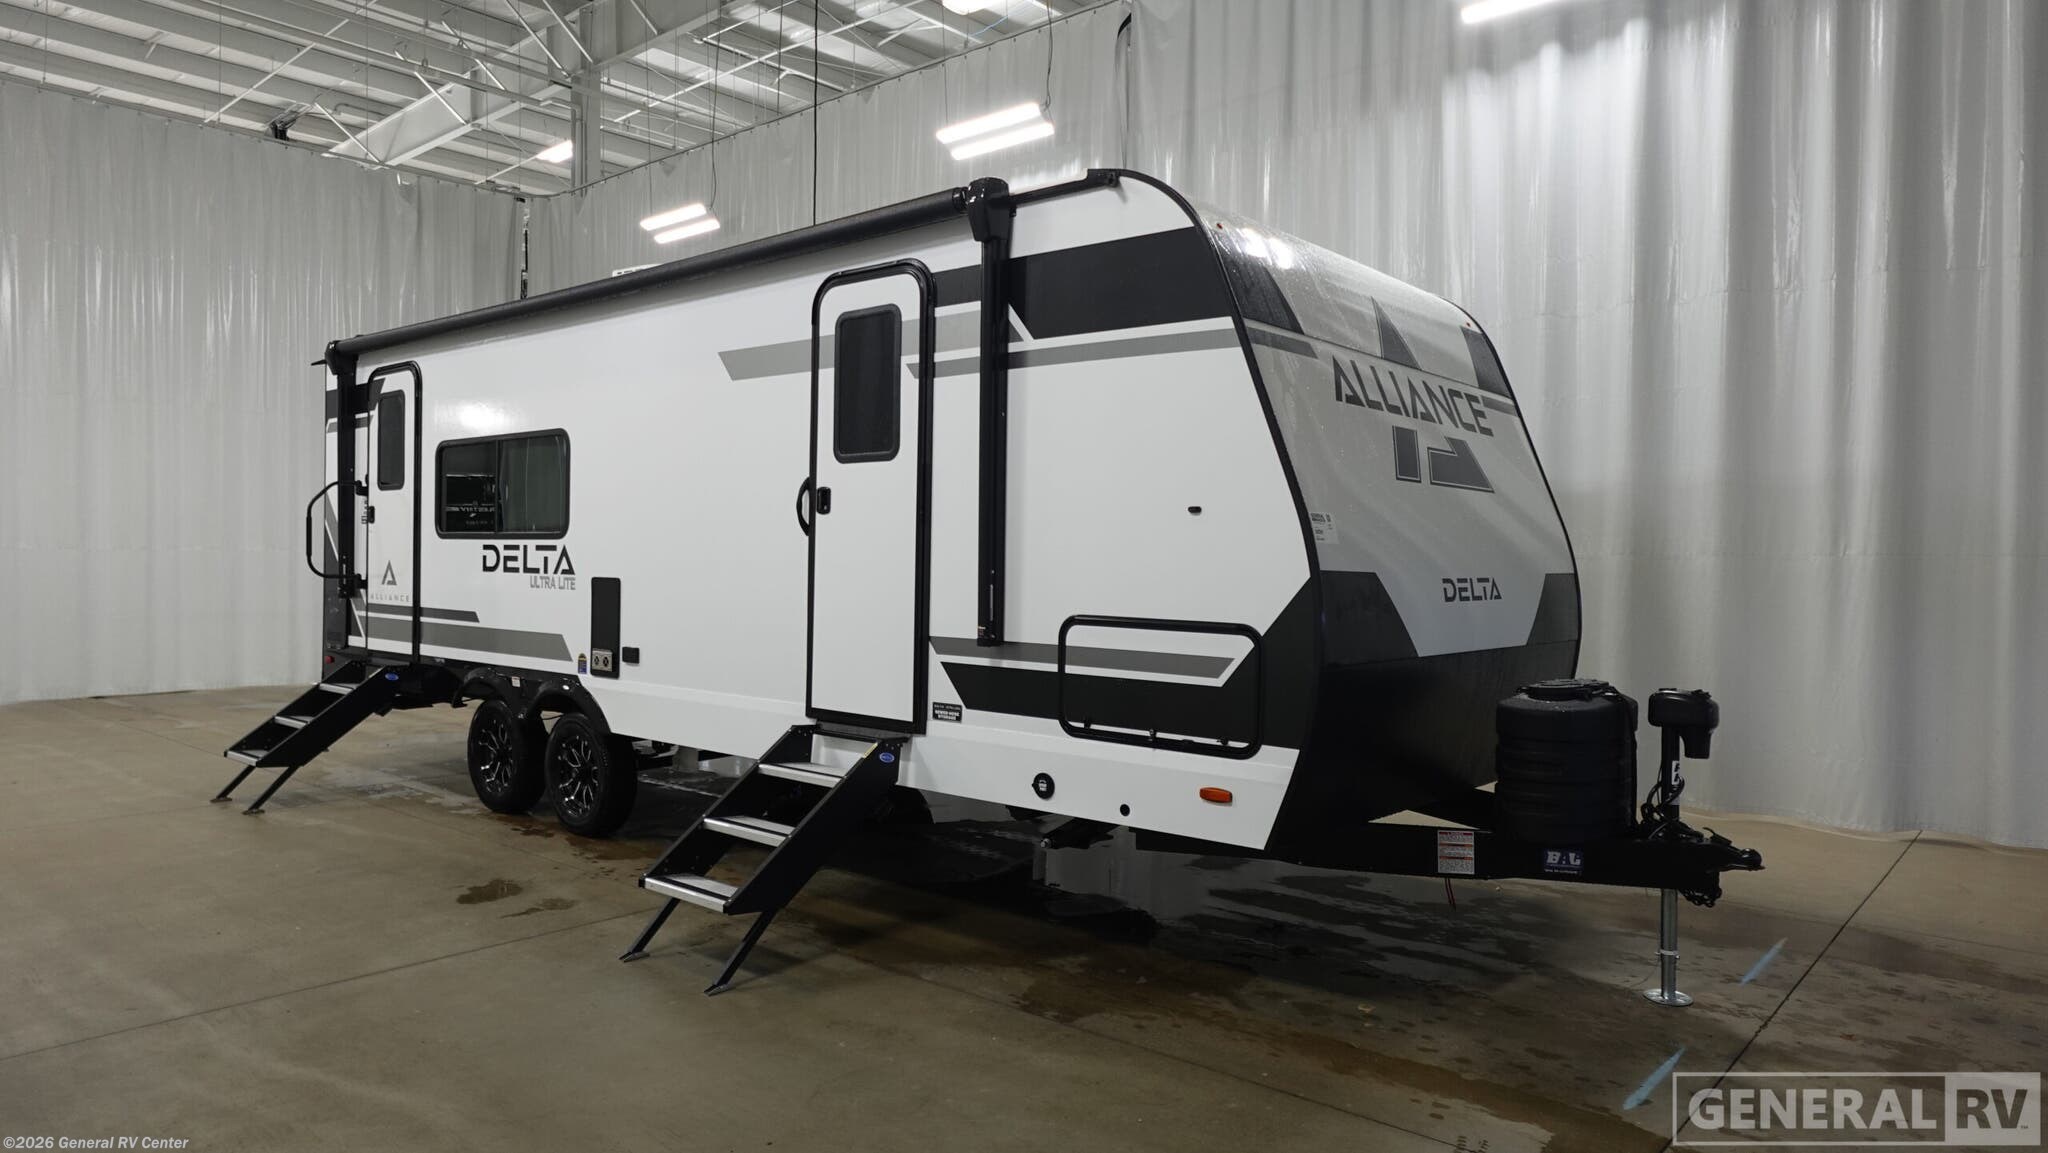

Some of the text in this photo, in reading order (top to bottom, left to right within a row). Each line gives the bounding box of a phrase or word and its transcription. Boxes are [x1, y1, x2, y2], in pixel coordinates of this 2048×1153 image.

[1332, 355, 1494, 437] ALLIANCE
[482, 544, 576, 575] DELTA
[529, 575, 576, 591] ULTRA LITE
[1442, 577, 1502, 602] DELTA
[370, 592, 410, 602] ALLIANCE
